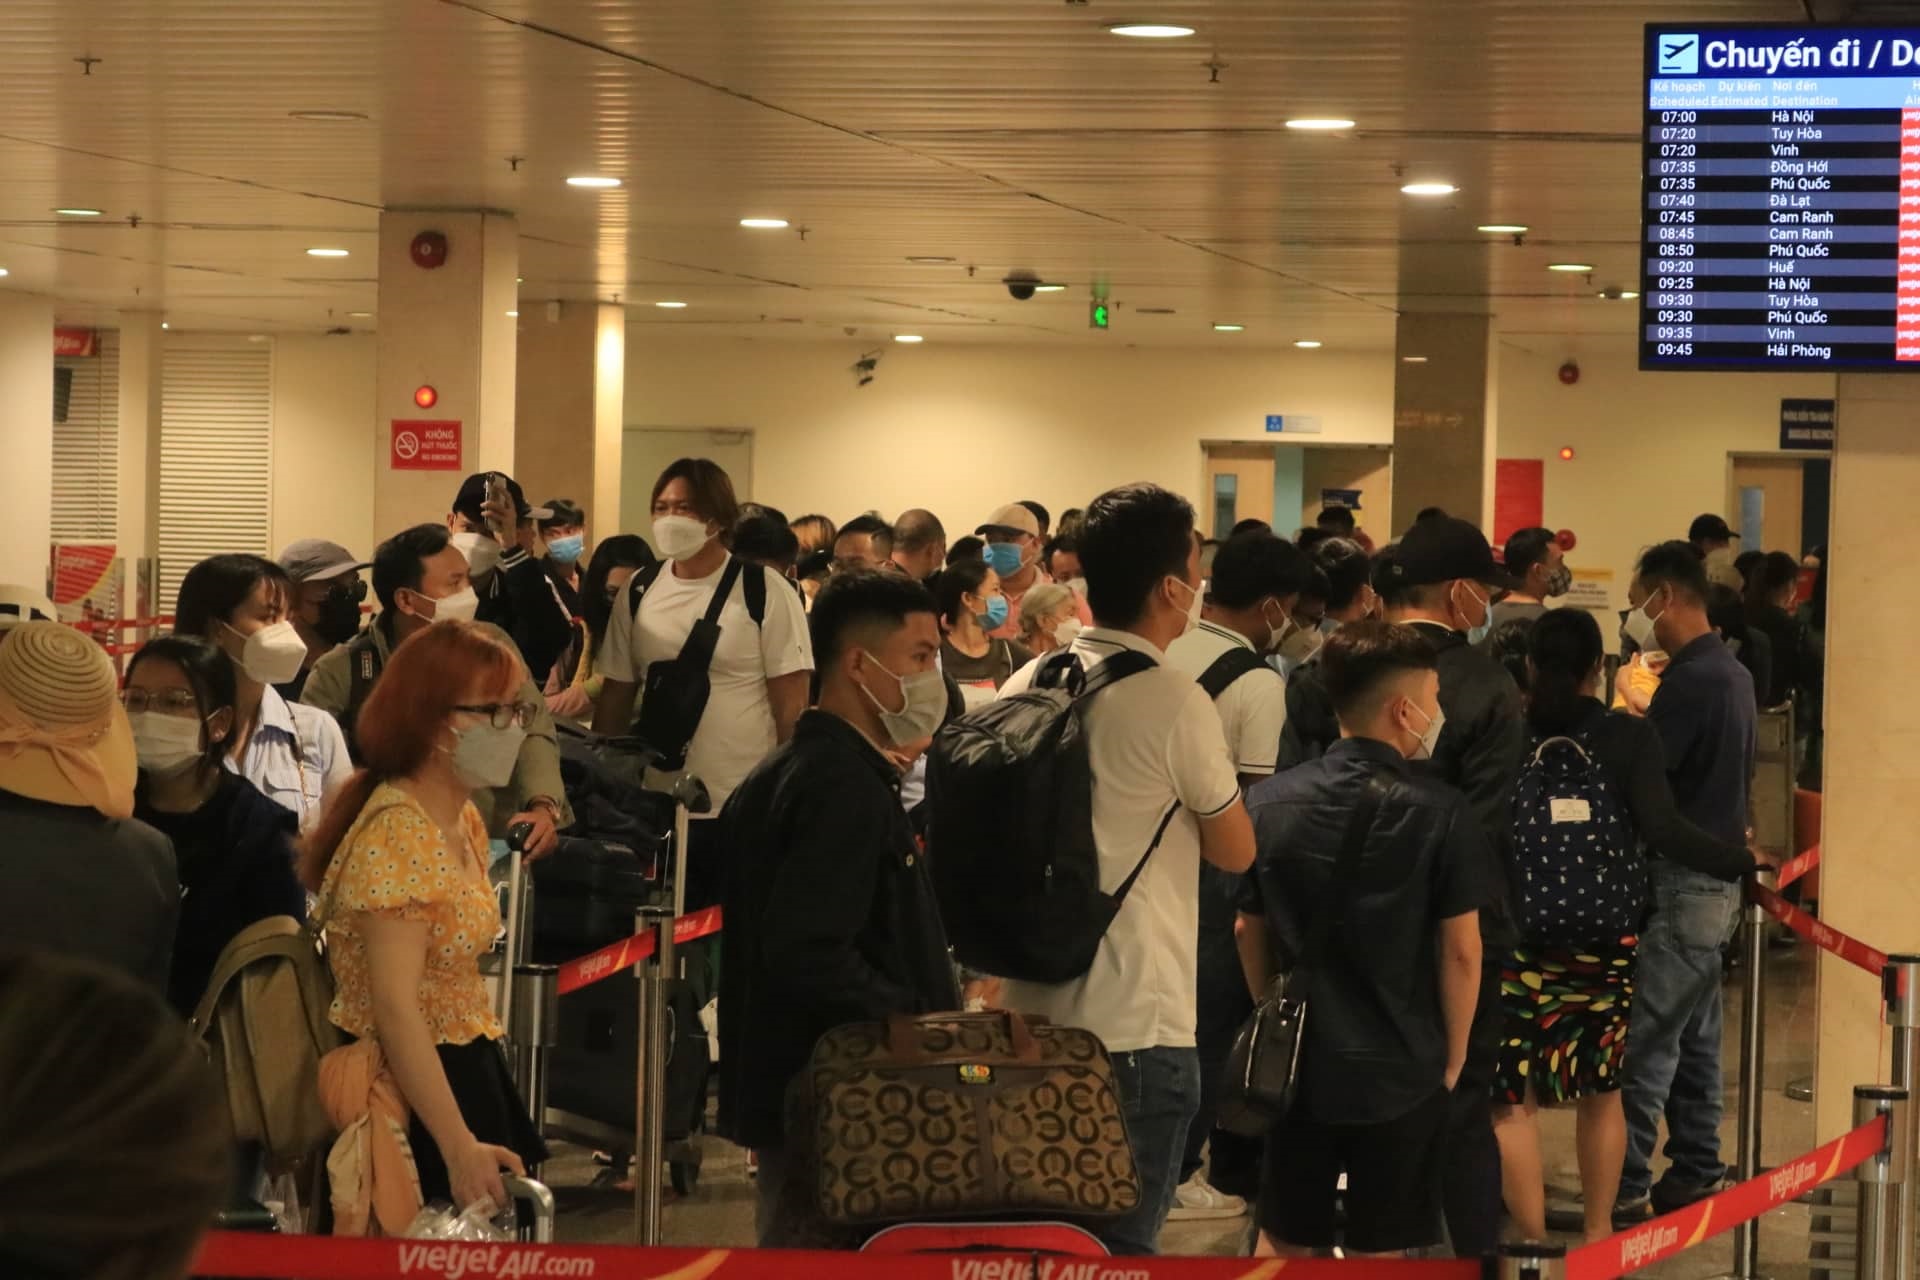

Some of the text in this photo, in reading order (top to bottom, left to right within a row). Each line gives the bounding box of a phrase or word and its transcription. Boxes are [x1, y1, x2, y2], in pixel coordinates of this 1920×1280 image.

[1705, 37, 1821, 74] Chuyến
[1829, 38, 1861, 67] đi
[1867, 39, 1883, 69] /
[1650, 96, 1709, 106] Scheduled
[1711, 95, 1768, 106] Estimated
[1772, 95, 1839, 106] Destination
[1662, 111, 1814, 124] 07:00 Hà Nội
[1661, 127, 1823, 142] 07:20 Tuy Hòa
[1661, 144, 1799, 156] 07:20 Vinh
[1660, 160, 1829, 176] 07:35 Đồng Hới
[1660, 176, 1831, 191] 07:35 Phú Quốc
[1660, 194, 1811, 209] 07:40 Đà Lạt
[1660, 211, 1834, 223] 07:45 Cam Ranh
[1659, 228, 1834, 240] 08:45 Cam Ranh
[1659, 243, 1829, 258] 08:50 Phú Quốc
[1659, 259, 1795, 273] 09:20 Huế
[1658, 277, 1810, 292] 09:25 Hà Nội
[1658, 294, 1819, 309] 09:30 Tuy Hòa
[1658, 310, 1828, 324] 09:30 Phú Quốc
[1657, 327, 1795, 339] 09:35 Vinh
[1657, 342, 1831, 360] 09:45 Hải Phòng
[425, 428, 454, 440] KHÔNG
